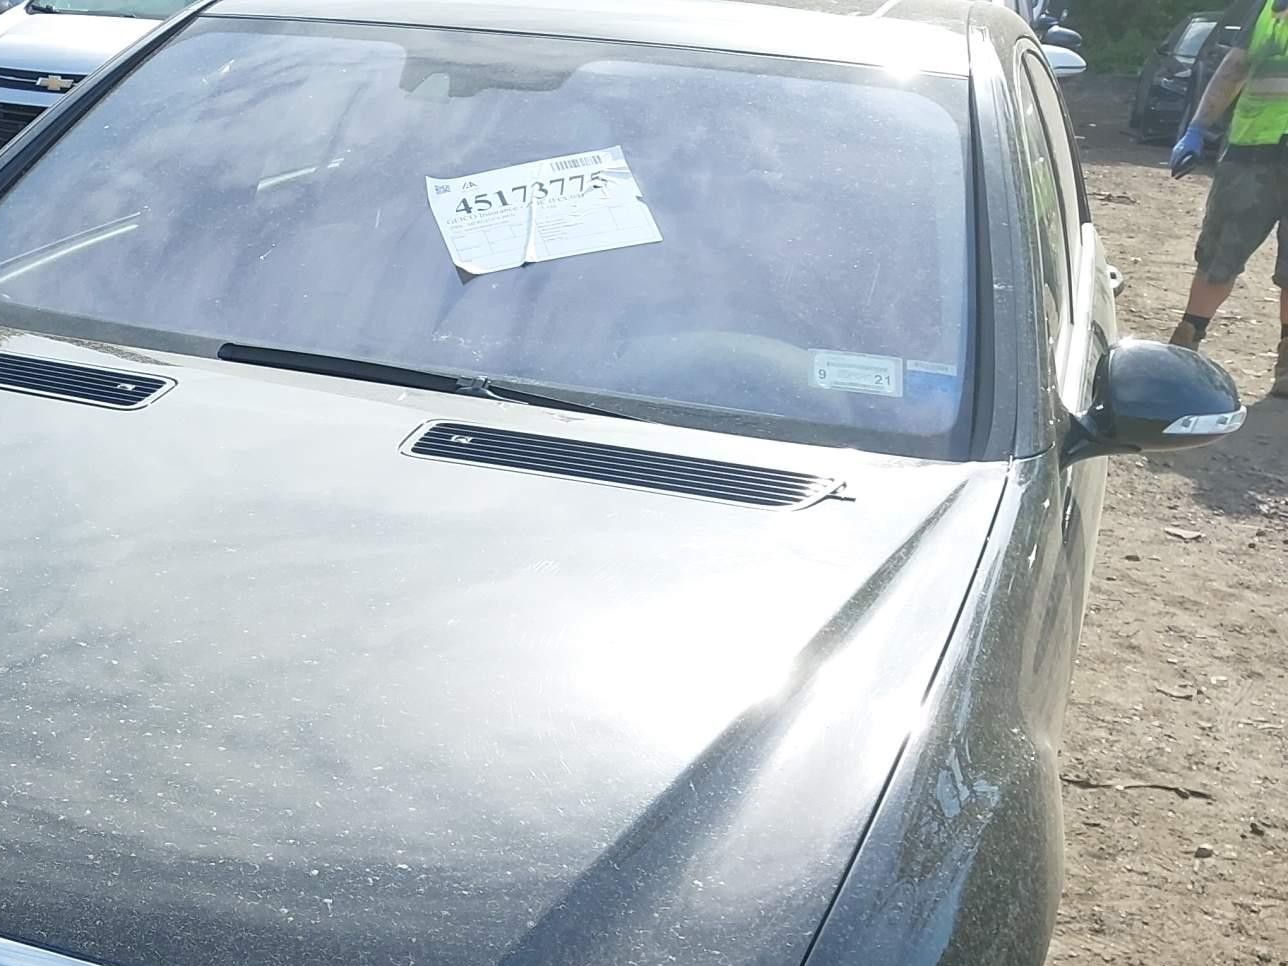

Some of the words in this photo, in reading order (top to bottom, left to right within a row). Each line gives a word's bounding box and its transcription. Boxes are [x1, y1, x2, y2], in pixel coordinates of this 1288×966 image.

[455, 171, 609, 214] 45173775
[818, 368, 827, 380] 9
[874, 374, 891, 386] 21
